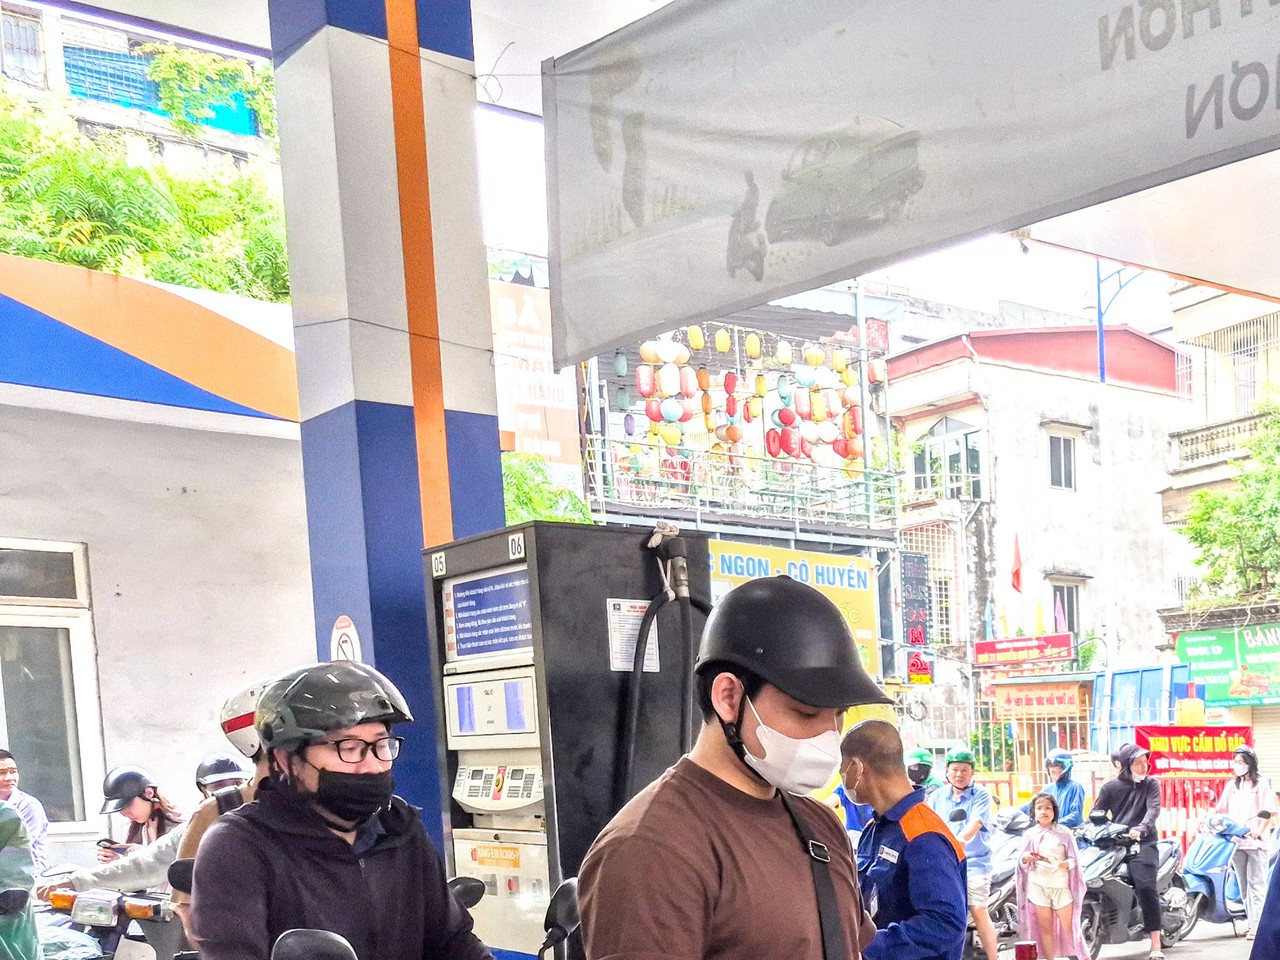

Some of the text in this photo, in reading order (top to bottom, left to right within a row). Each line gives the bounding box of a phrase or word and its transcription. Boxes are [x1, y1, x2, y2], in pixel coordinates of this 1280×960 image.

[510, 536, 522, 556] 06
[434, 555, 444, 573] 05
[720, 554, 770, 577] NGON
[787, 560, 809, 583] CÔ
[1171, 735, 1190, 756] VỰC
[1193, 731, 1213, 752] CẤM
[1214, 731, 1227, 752] ĐỔ
